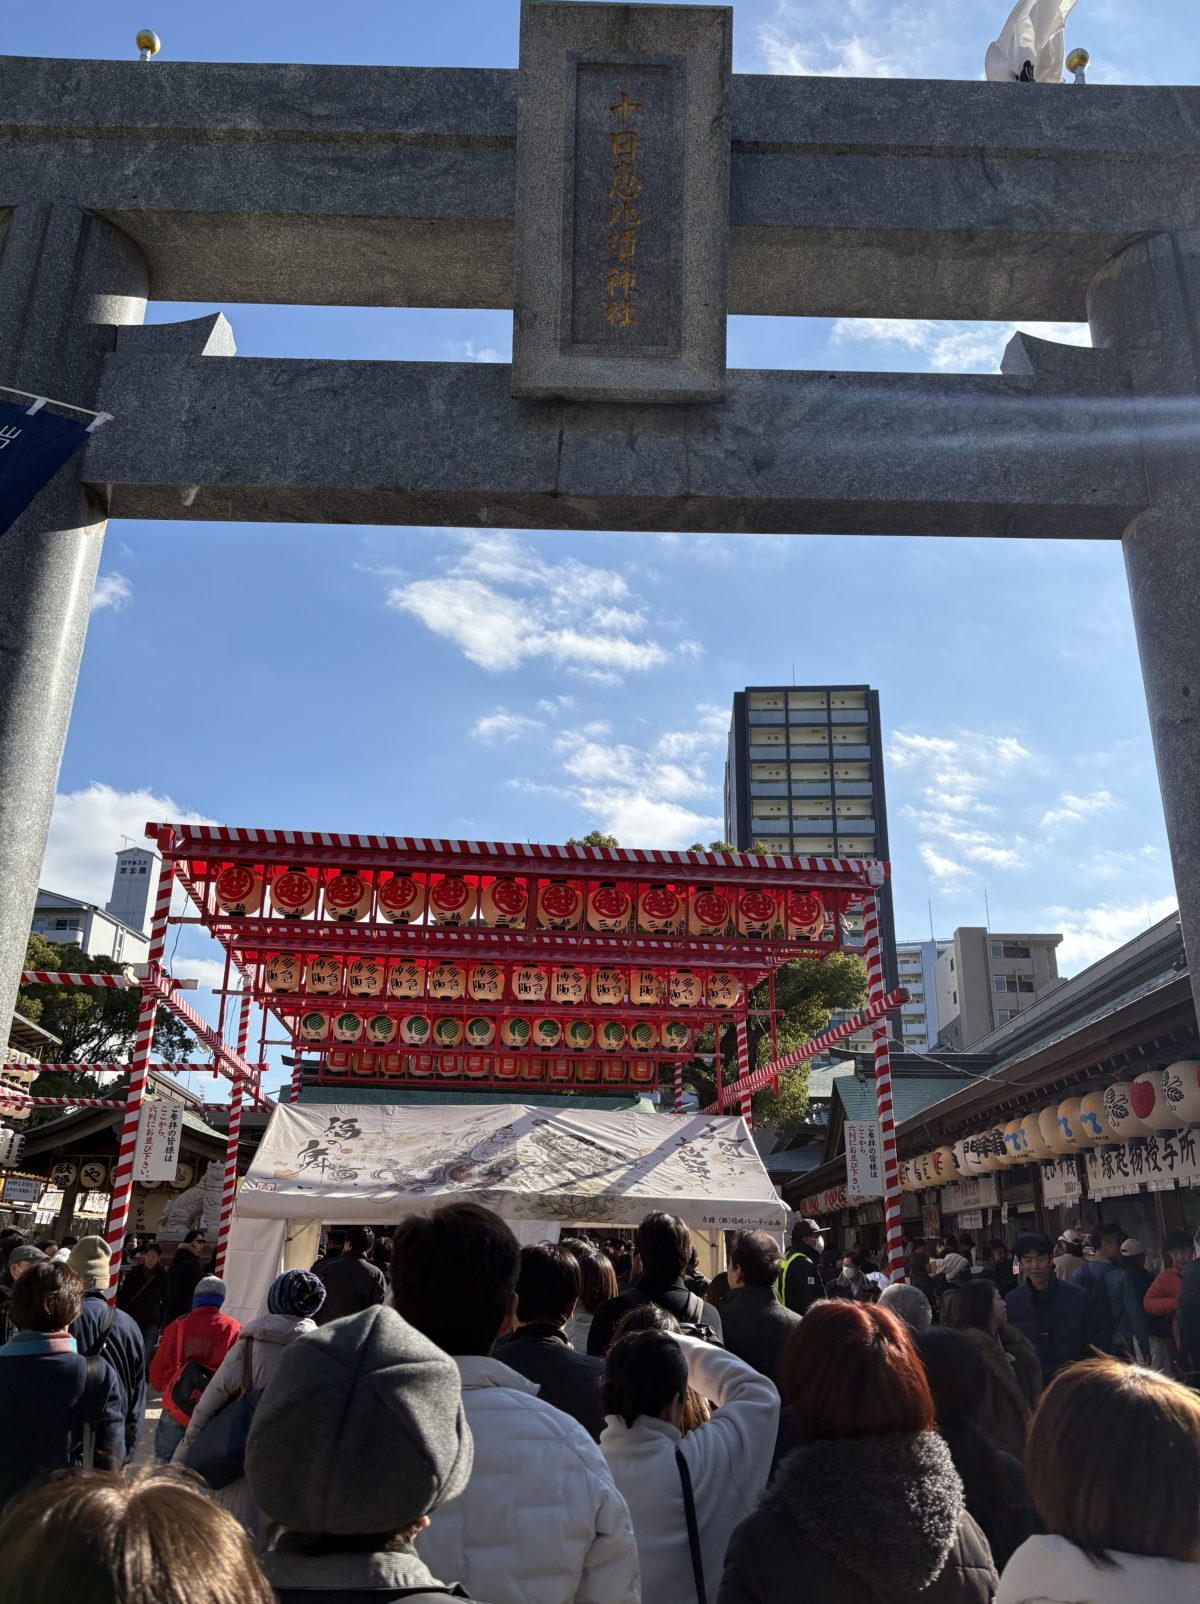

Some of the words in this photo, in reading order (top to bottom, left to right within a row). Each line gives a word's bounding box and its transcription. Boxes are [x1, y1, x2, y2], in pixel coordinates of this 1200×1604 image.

[222, 902, 246, 912] 三越
[330, 908, 358, 917] 三越
[386, 910, 411, 919] 三越
[438, 912, 462, 921] 三越
[496, 914, 519, 924] 三越
[598, 919, 622, 928] 三越
[648, 920, 673, 929] 三越
[744, 920, 769, 931] 三越
[700, 926, 721, 934] 三越
[795, 926, 817, 936] 三越
[312, 960, 340, 972] 博多
[350, 962, 378, 975] 博多
[392, 966, 418, 976] 博多
[432, 967, 460, 978] 博多
[473, 968, 498, 979] 博多
[518, 972, 544, 982] 博多
[556, 972, 582, 982] 博多
[596, 972, 622, 984] 博多
[312, 973, 338, 986] 阪急
[350, 976, 377, 990] 阪急
[391, 978, 418, 990] 阪急
[433, 979, 459, 991] 阪急
[473, 980, 498, 993] 阪急
[518, 983, 543, 996] 阪急
[556, 984, 582, 996] 阪急
[596, 984, 622, 998] 阪急
[158, 1105, 167, 1138] ここから、
[164, 1105, 180, 1162] ご参拝の皆様は
[140, 1104, 158, 1178] 六列にお並び下さい。
[858, 1125, 868, 1156] ここから、
[868, 1124, 878, 1178] ご参拝の皆様は
[848, 1124, 860, 1193] 六列にお並び下さい。
[84, 1168, 100, 1183] や
